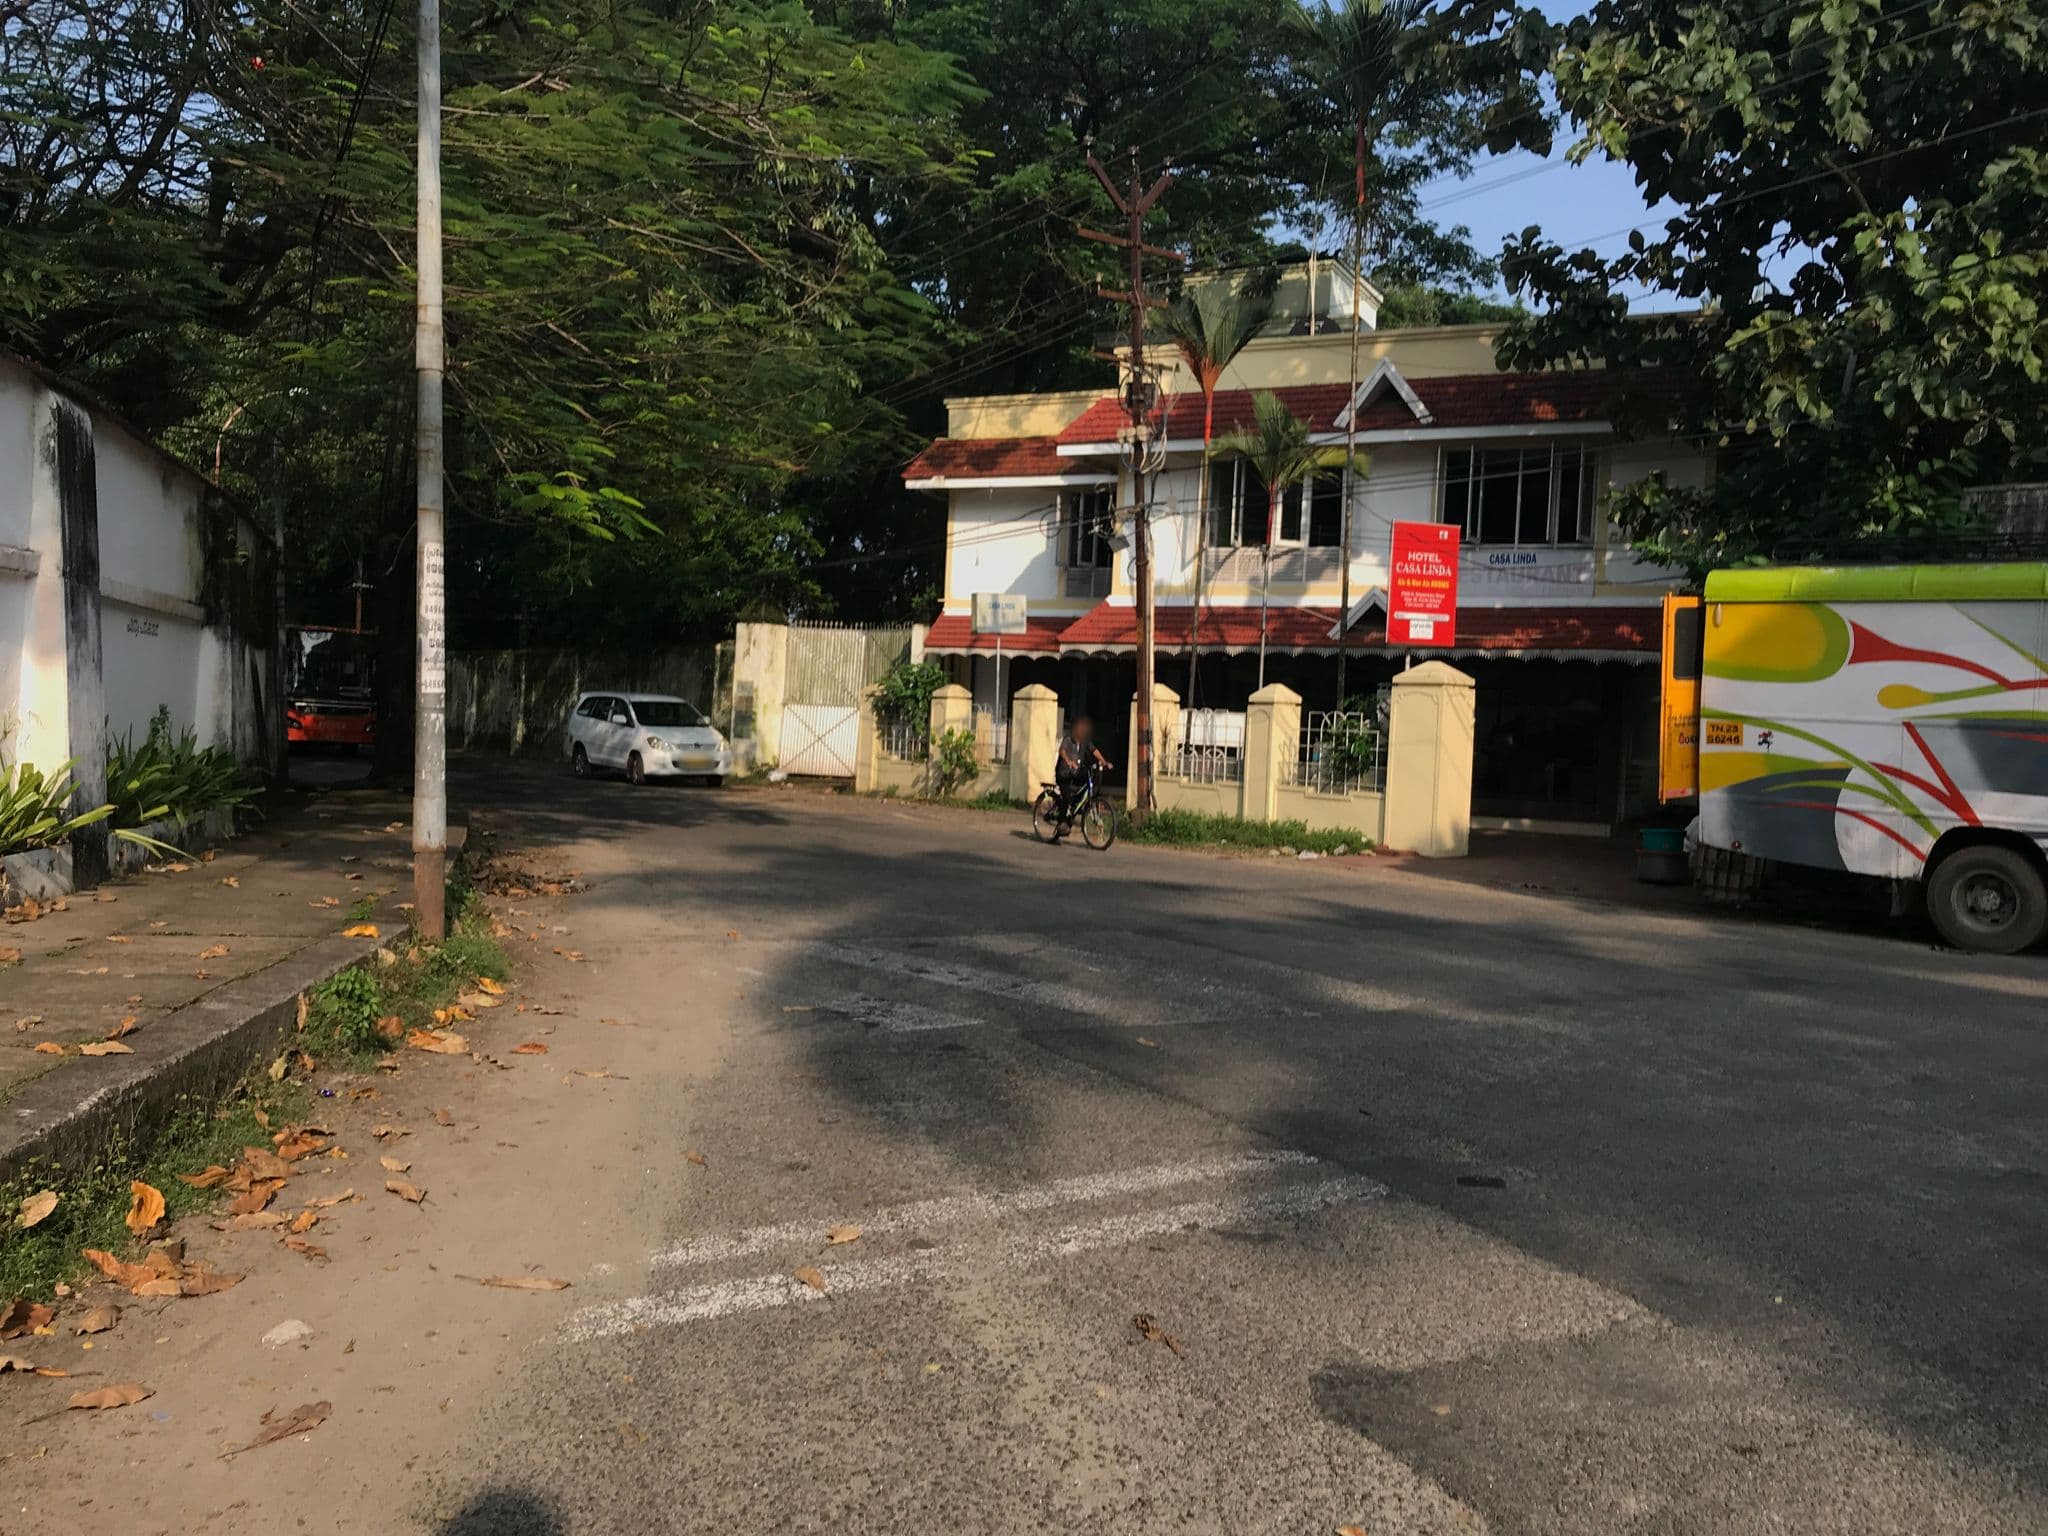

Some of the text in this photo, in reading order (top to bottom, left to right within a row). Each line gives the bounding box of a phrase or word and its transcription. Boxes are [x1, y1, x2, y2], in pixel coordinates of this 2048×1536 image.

[1408, 552, 1441, 563] HOTEL
[1489, 552, 1537, 565] CASA LINDA
[1396, 562, 1451, 577] CASA LINDA
